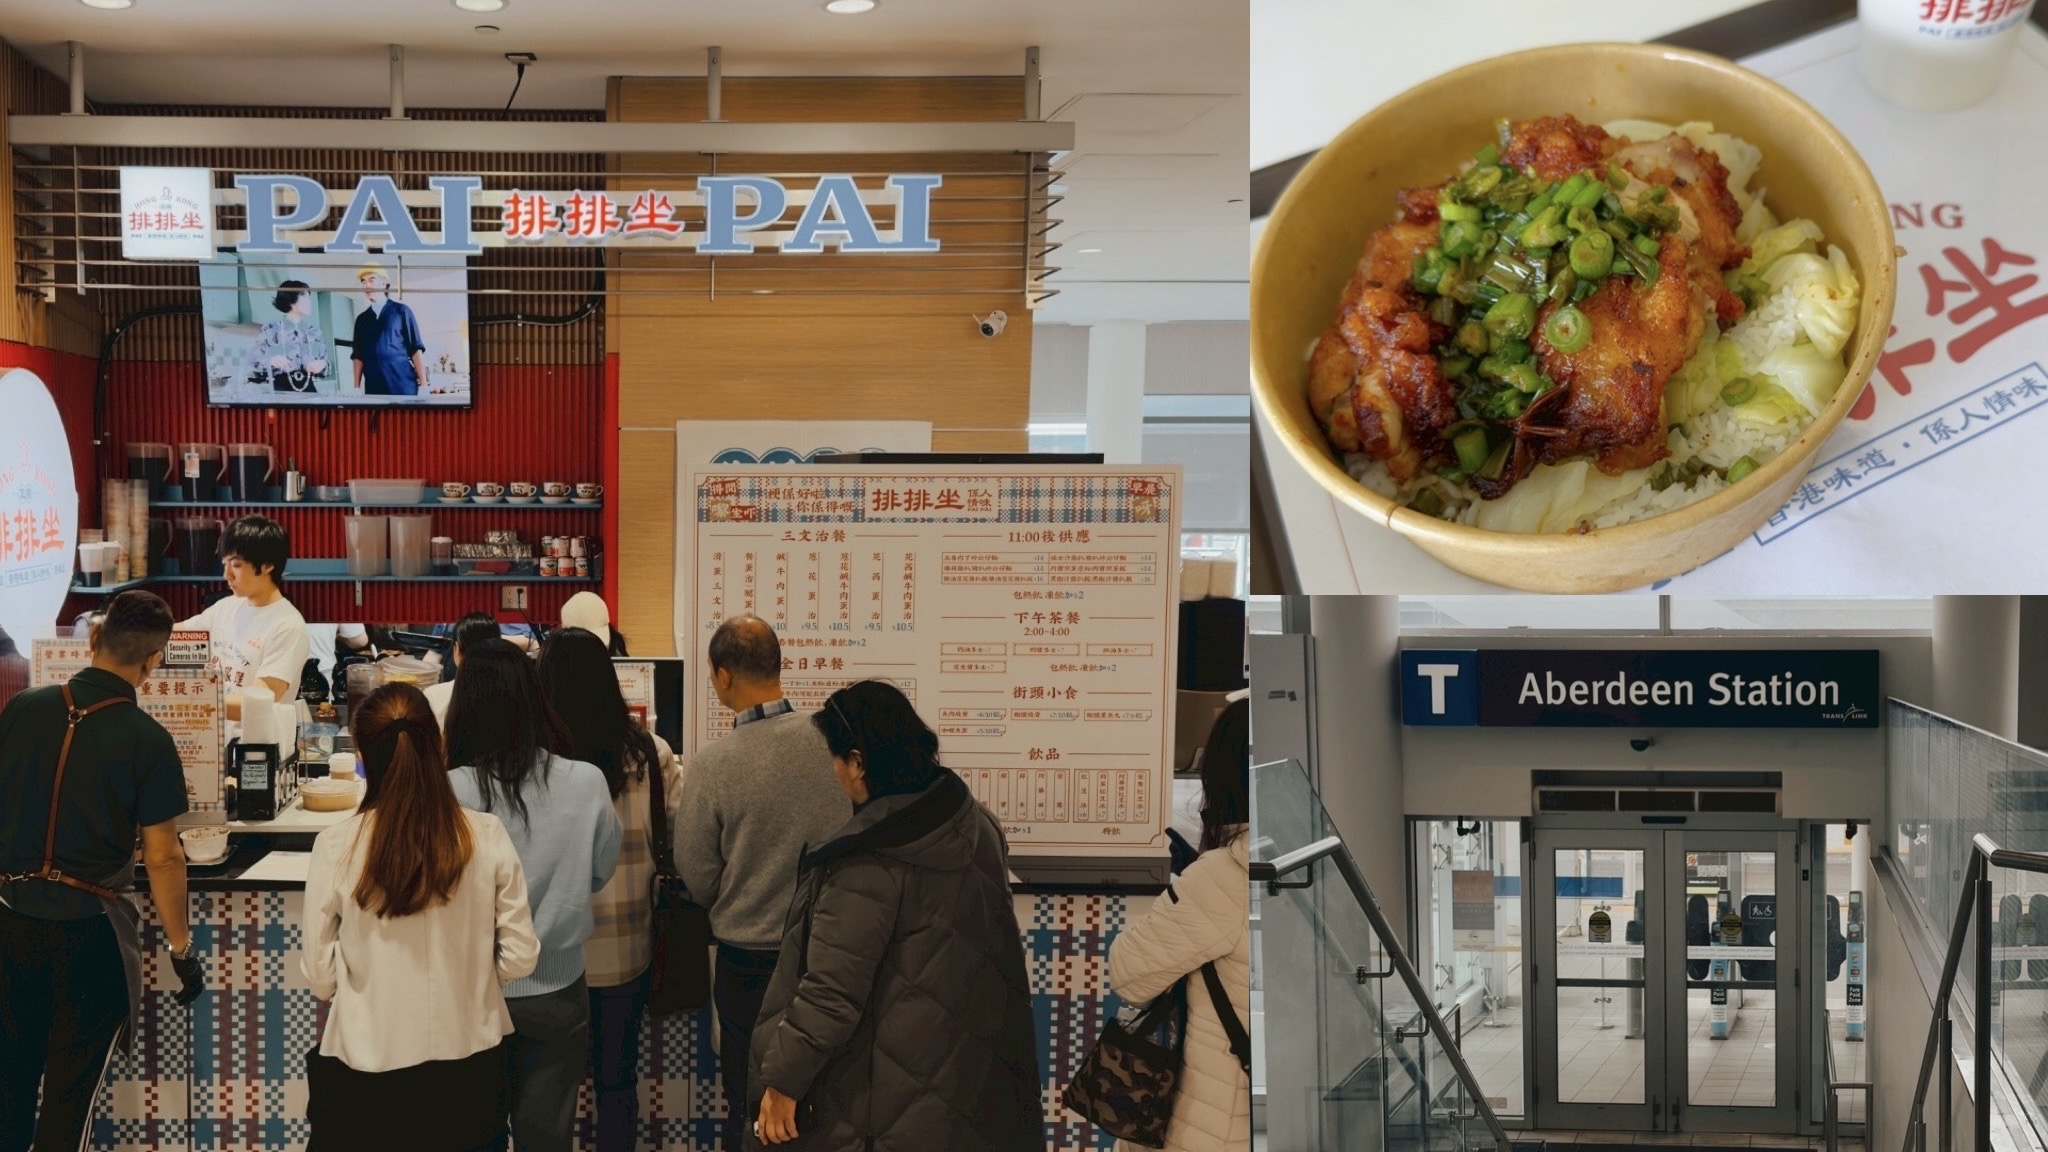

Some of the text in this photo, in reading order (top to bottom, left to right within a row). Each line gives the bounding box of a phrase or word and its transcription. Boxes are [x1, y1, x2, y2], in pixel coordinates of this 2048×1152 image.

[134, 196, 157, 210] HONG
[176, 196, 199, 210] KONG
[234, 175, 484, 253] PAI
[502, 190, 685, 237] 排排坐
[697, 174, 941, 252] PAI
[128, 211, 204, 230] 排排坐
[872, 488, 965, 512] 排排坐
[781, 530, 847, 543] 三文治餐
[1008, 530, 1090, 543] 11:00後供應
[1013, 611, 1081, 625] 下午茶餐
[801, 621, 818, 631] $9.5
[829, 621, 849, 631] $10.5
[864, 621, 881, 631] $9.5
[892, 621, 914, 631] $10.5
[1024, 627, 1070, 637] 2:00-4:00
[170, 632, 208, 640] WARNING
[169, 644, 192, 652] Security
[781, 657, 845, 670] 全日早餐
[140, 681, 205, 696] 重要提示
[1013, 686, 1079, 700] 街頭小食
[1417, 663, 1460, 715] T
[1518, 671, 1839, 706] Aberdeen Station
[1028, 747, 1061, 761] 飲品
